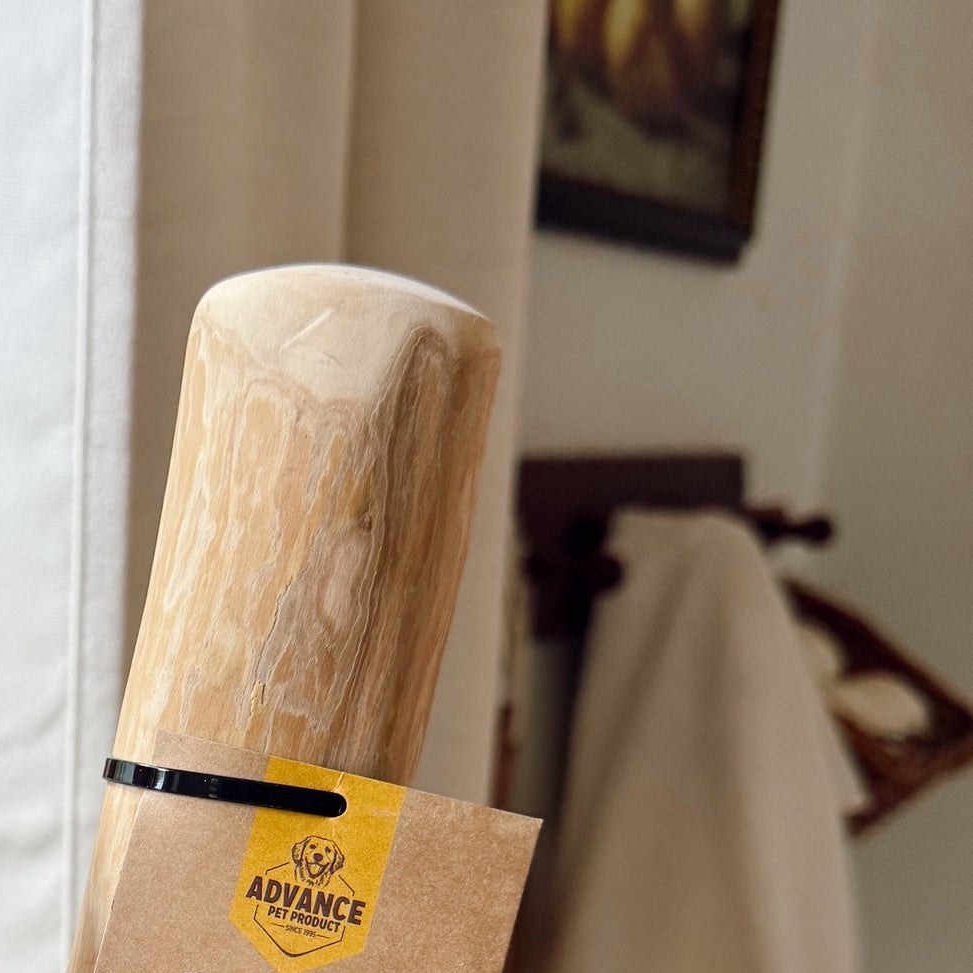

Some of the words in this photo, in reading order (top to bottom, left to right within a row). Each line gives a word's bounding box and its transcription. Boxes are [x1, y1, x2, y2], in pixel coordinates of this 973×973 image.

[246, 876, 366, 925] ADVANCE
[268, 906, 289, 920] PET
[290, 912, 341, 933] PRODUCT
[285, 925, 303, 935] SINCE
[303, 929, 316, 938] 1995
